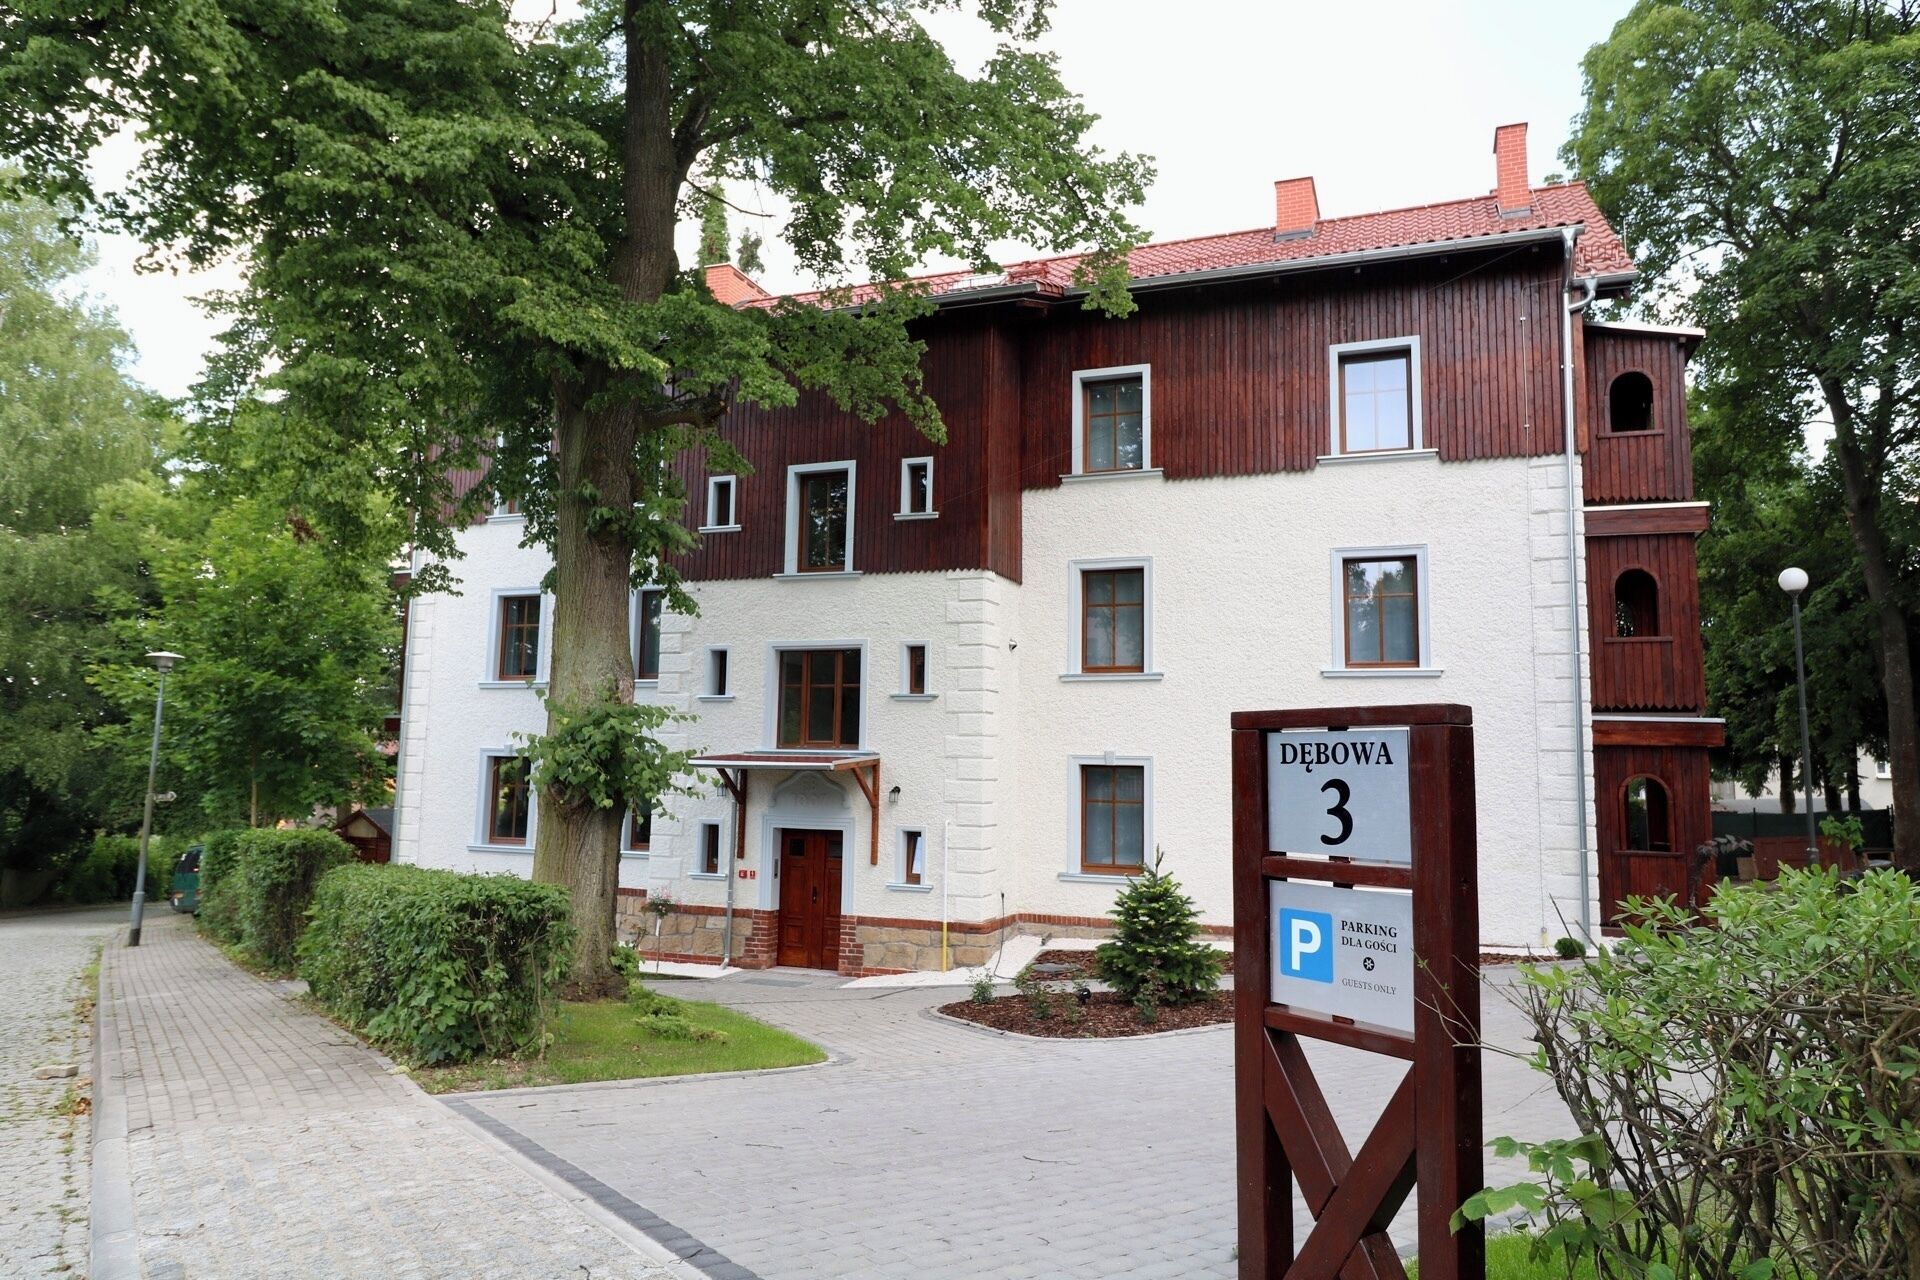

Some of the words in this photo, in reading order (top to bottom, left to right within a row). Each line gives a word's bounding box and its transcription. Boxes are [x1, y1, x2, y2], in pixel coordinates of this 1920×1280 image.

[1280, 741, 1394, 773] DĘBOWA
[1321, 778, 1353, 846] 3
[1341, 920, 1397, 938] PARKING
[1291, 918, 1321, 971] P
[1341, 936, 1362, 948] DLA
[1365, 939, 1397, 953] GOŚCI
[1341, 978, 1373, 991] GUESTS
[1373, 983, 1396, 995] ONLY
